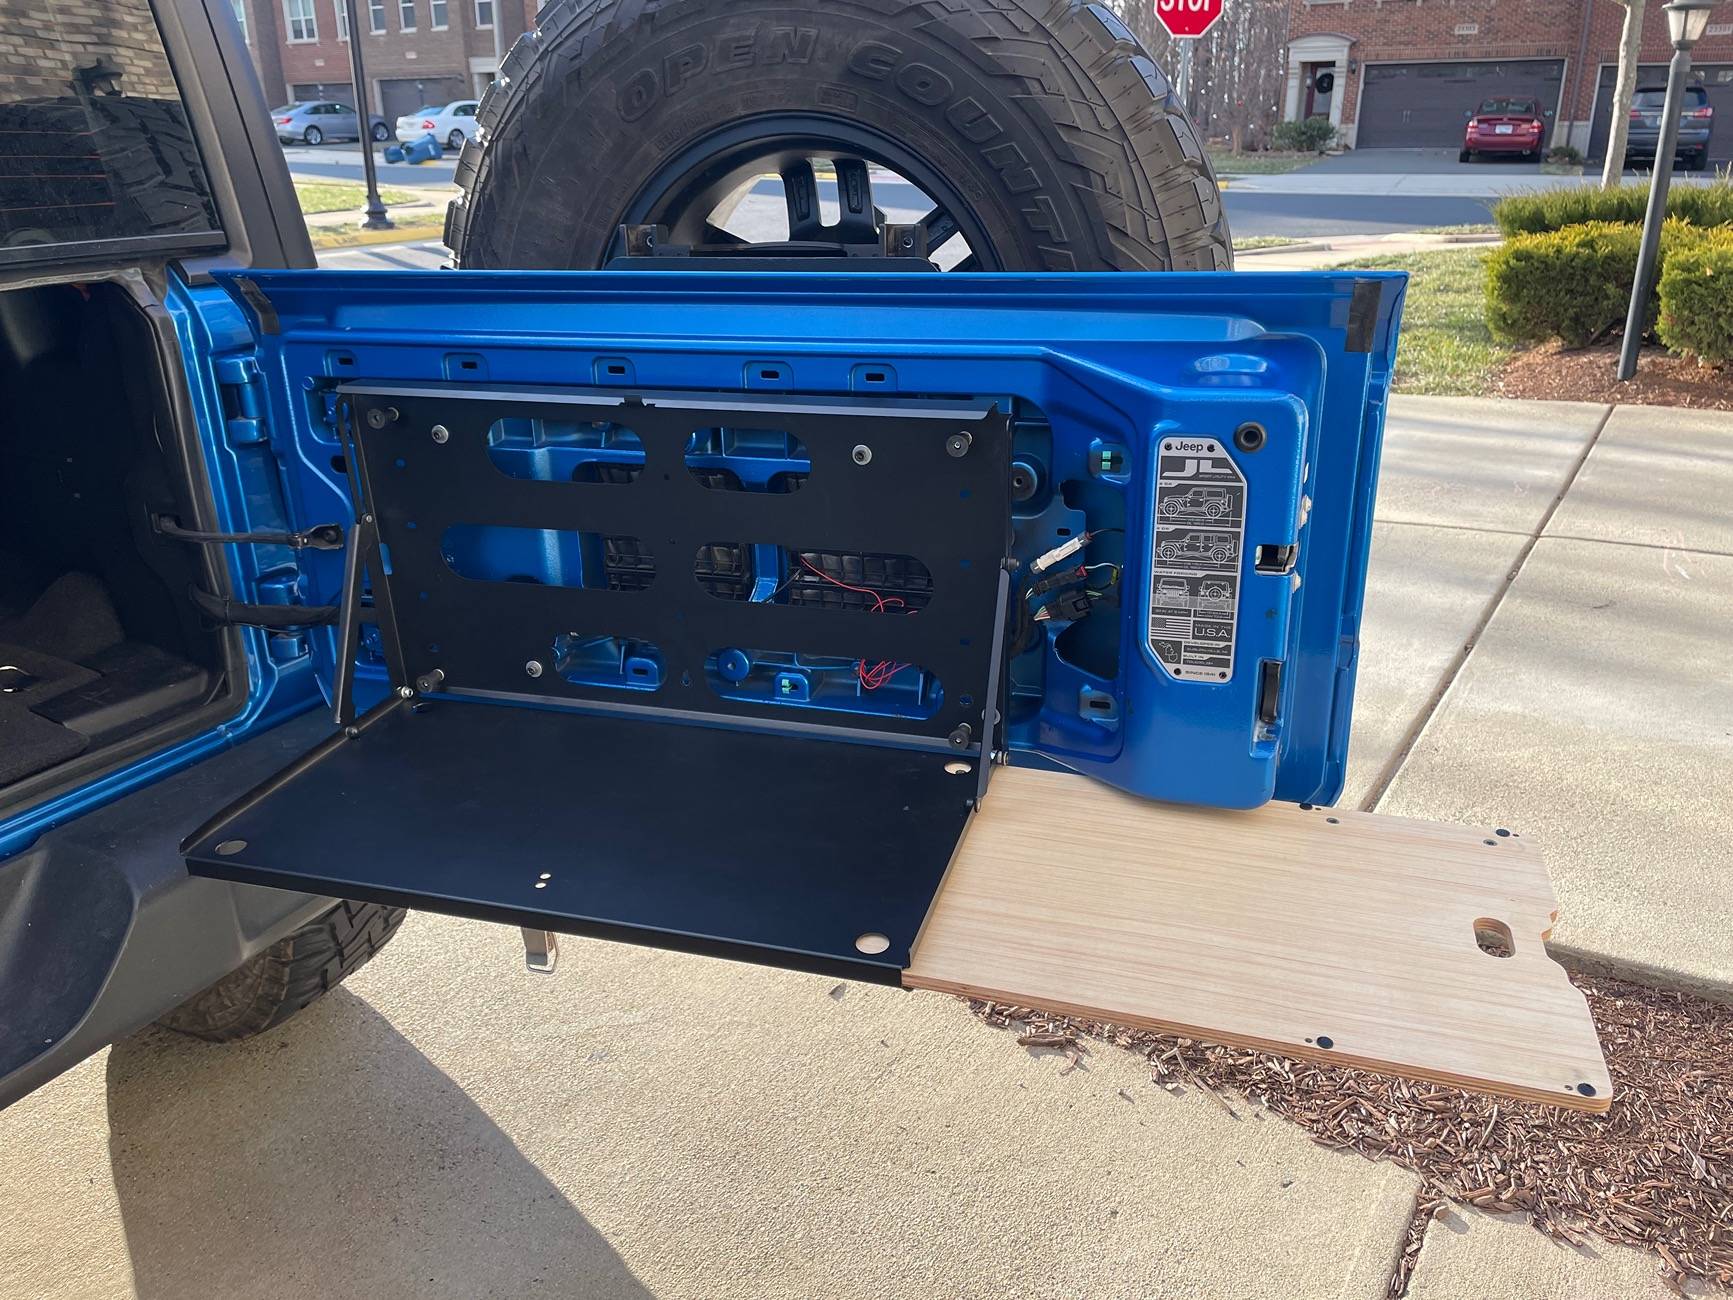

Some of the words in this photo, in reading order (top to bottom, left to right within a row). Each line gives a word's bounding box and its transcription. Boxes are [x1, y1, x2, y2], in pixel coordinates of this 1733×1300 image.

[615, 26, 820, 124] OPEN
[1175, 441, 1204, 453] Jeep
[1161, 459, 1233, 477] JL
[1194, 627, 1231, 638] U.S.A.
